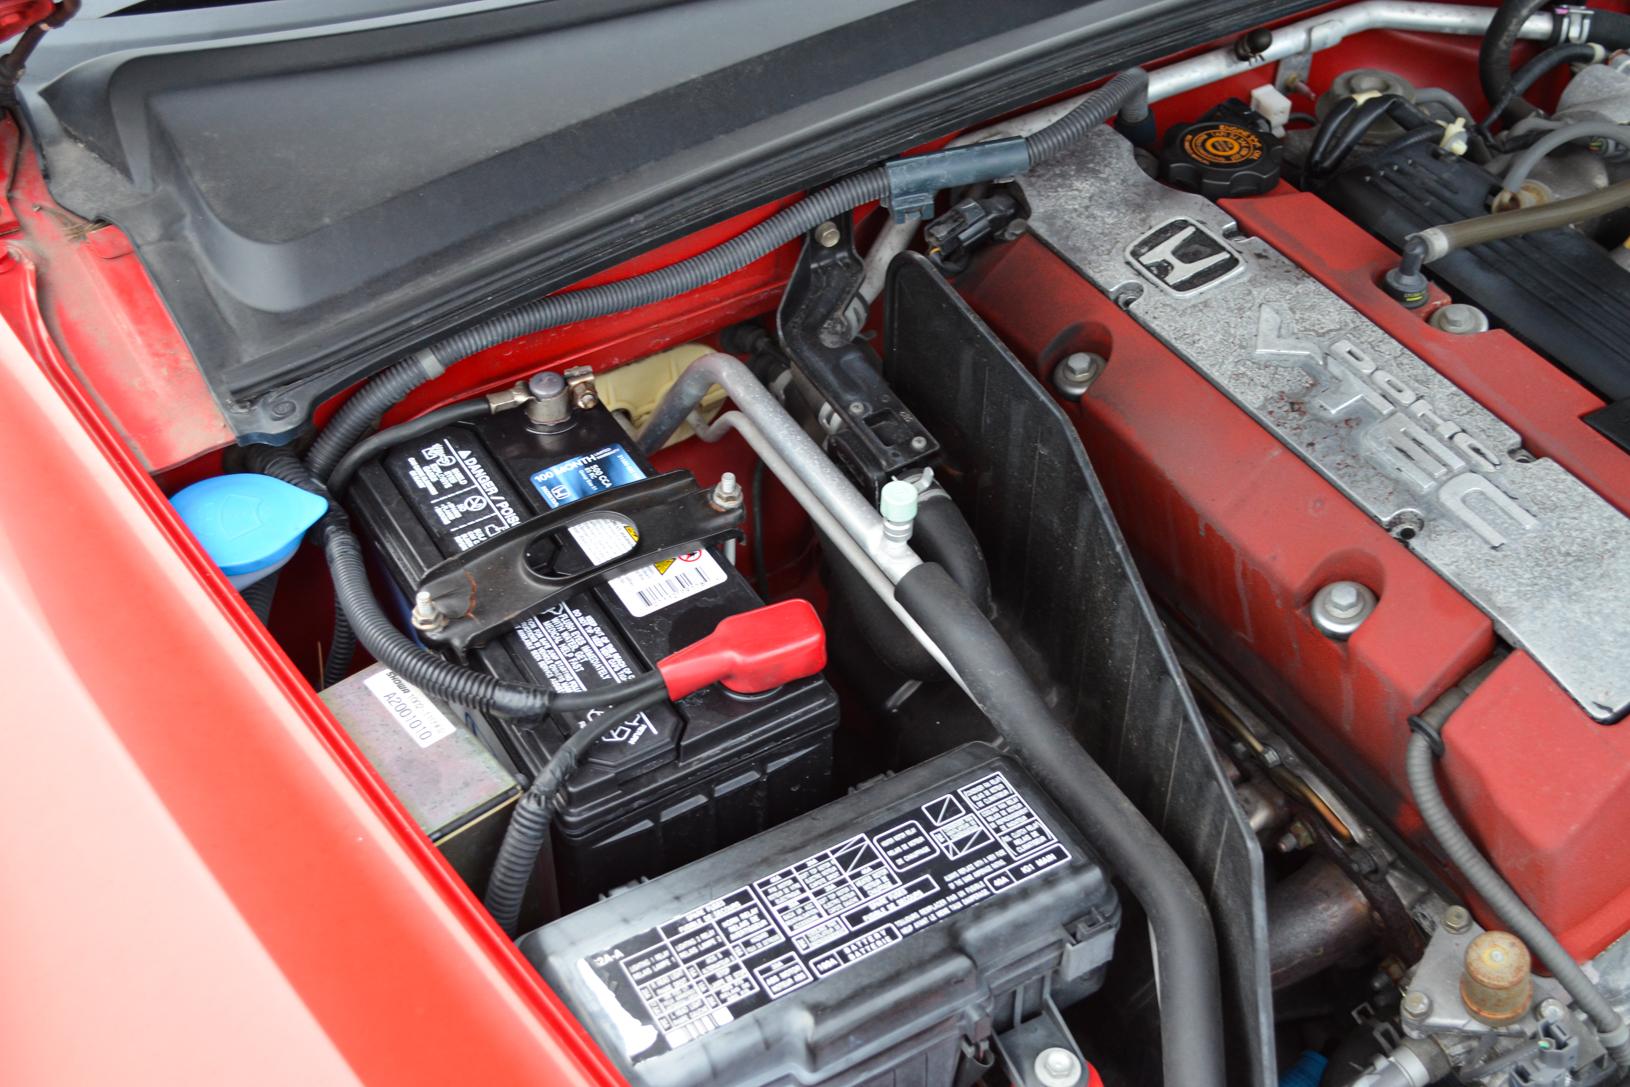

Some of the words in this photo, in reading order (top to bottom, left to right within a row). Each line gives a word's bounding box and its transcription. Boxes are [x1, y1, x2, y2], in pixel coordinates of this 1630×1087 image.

[1256, 302, 1540, 547] VTEC
[1330, 340, 1500, 472] DOHC
[535, 471, 554, 482] 100
[554, 455, 596, 477] MONTH
[590, 465, 603, 475] 500
[599, 475, 612, 487] CCA
[465, 458, 498, 495] DANGER
[496, 501, 520, 526] POIS
[543, 621, 563, 643] MEDICAL
[559, 643, 574, 657] HELP
[569, 657, 584, 672] FAST
[551, 617, 565, 631] WITH
[575, 651, 588, 662] GET
[559, 614, 576, 631] FLUSH
[571, 631, 586, 646] EYES
[581, 644, 610, 679] IMMEDIATELY
[386, 671, 410, 694] SHOWA
[384, 692, 433, 741] A2001010
[1035, 854, 1056, 866] MAIN
[842, 930, 888, 954] BATTERY
[848, 936, 893, 961] BATTERIE
